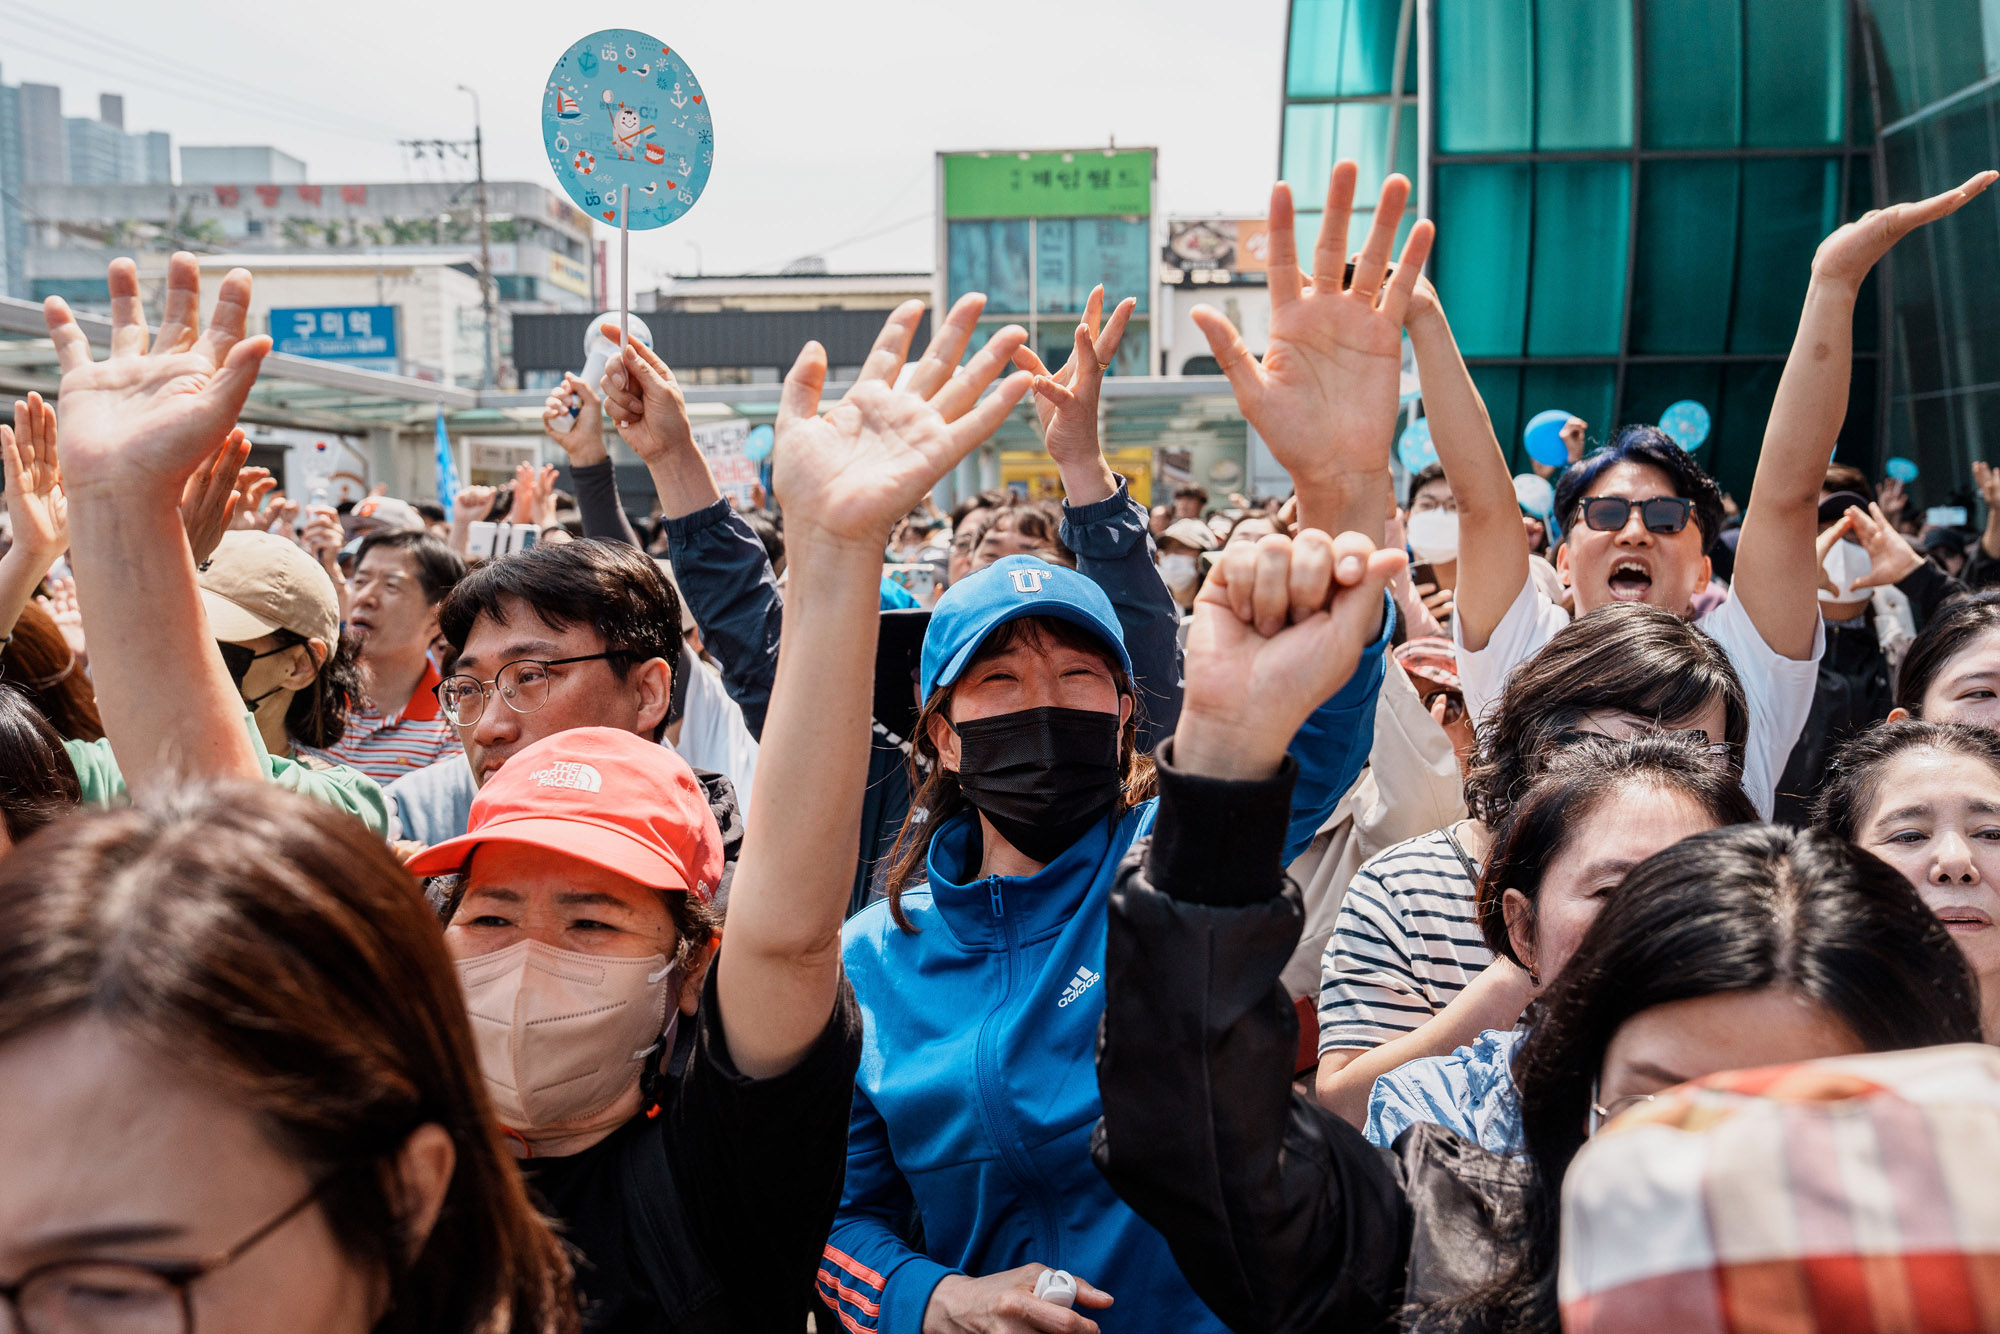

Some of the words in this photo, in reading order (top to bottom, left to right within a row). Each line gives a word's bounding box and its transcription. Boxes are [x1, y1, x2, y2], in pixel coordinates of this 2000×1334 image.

[292, 310, 372, 341] 구미역
[553, 761, 581, 772] THE
[528, 769, 578, 781] NORTH
[537, 778, 575, 788] FACE
[1058, 972, 1100, 1007] adidas
